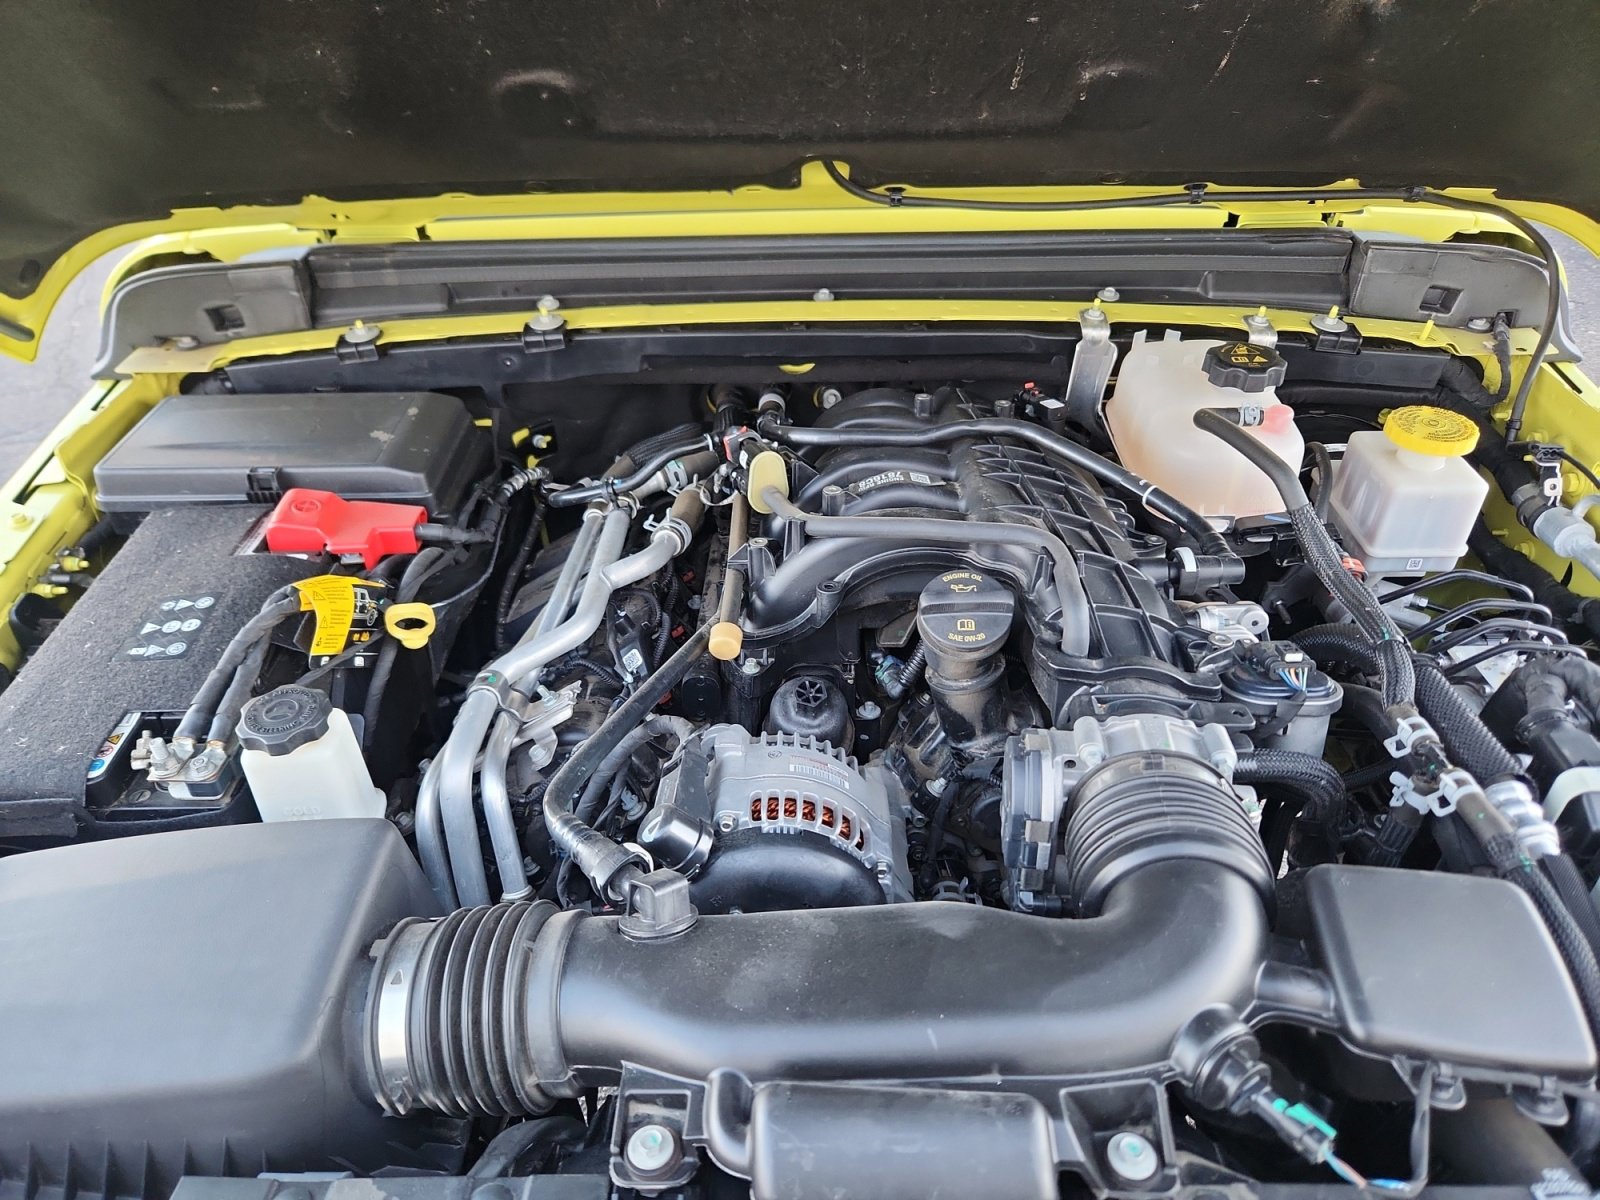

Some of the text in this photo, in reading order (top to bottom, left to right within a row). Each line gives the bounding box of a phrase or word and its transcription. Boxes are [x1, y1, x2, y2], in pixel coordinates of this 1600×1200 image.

[943, 573, 982, 582] ENGINE OIL
[948, 633, 985, 642] SAE 0W-20
